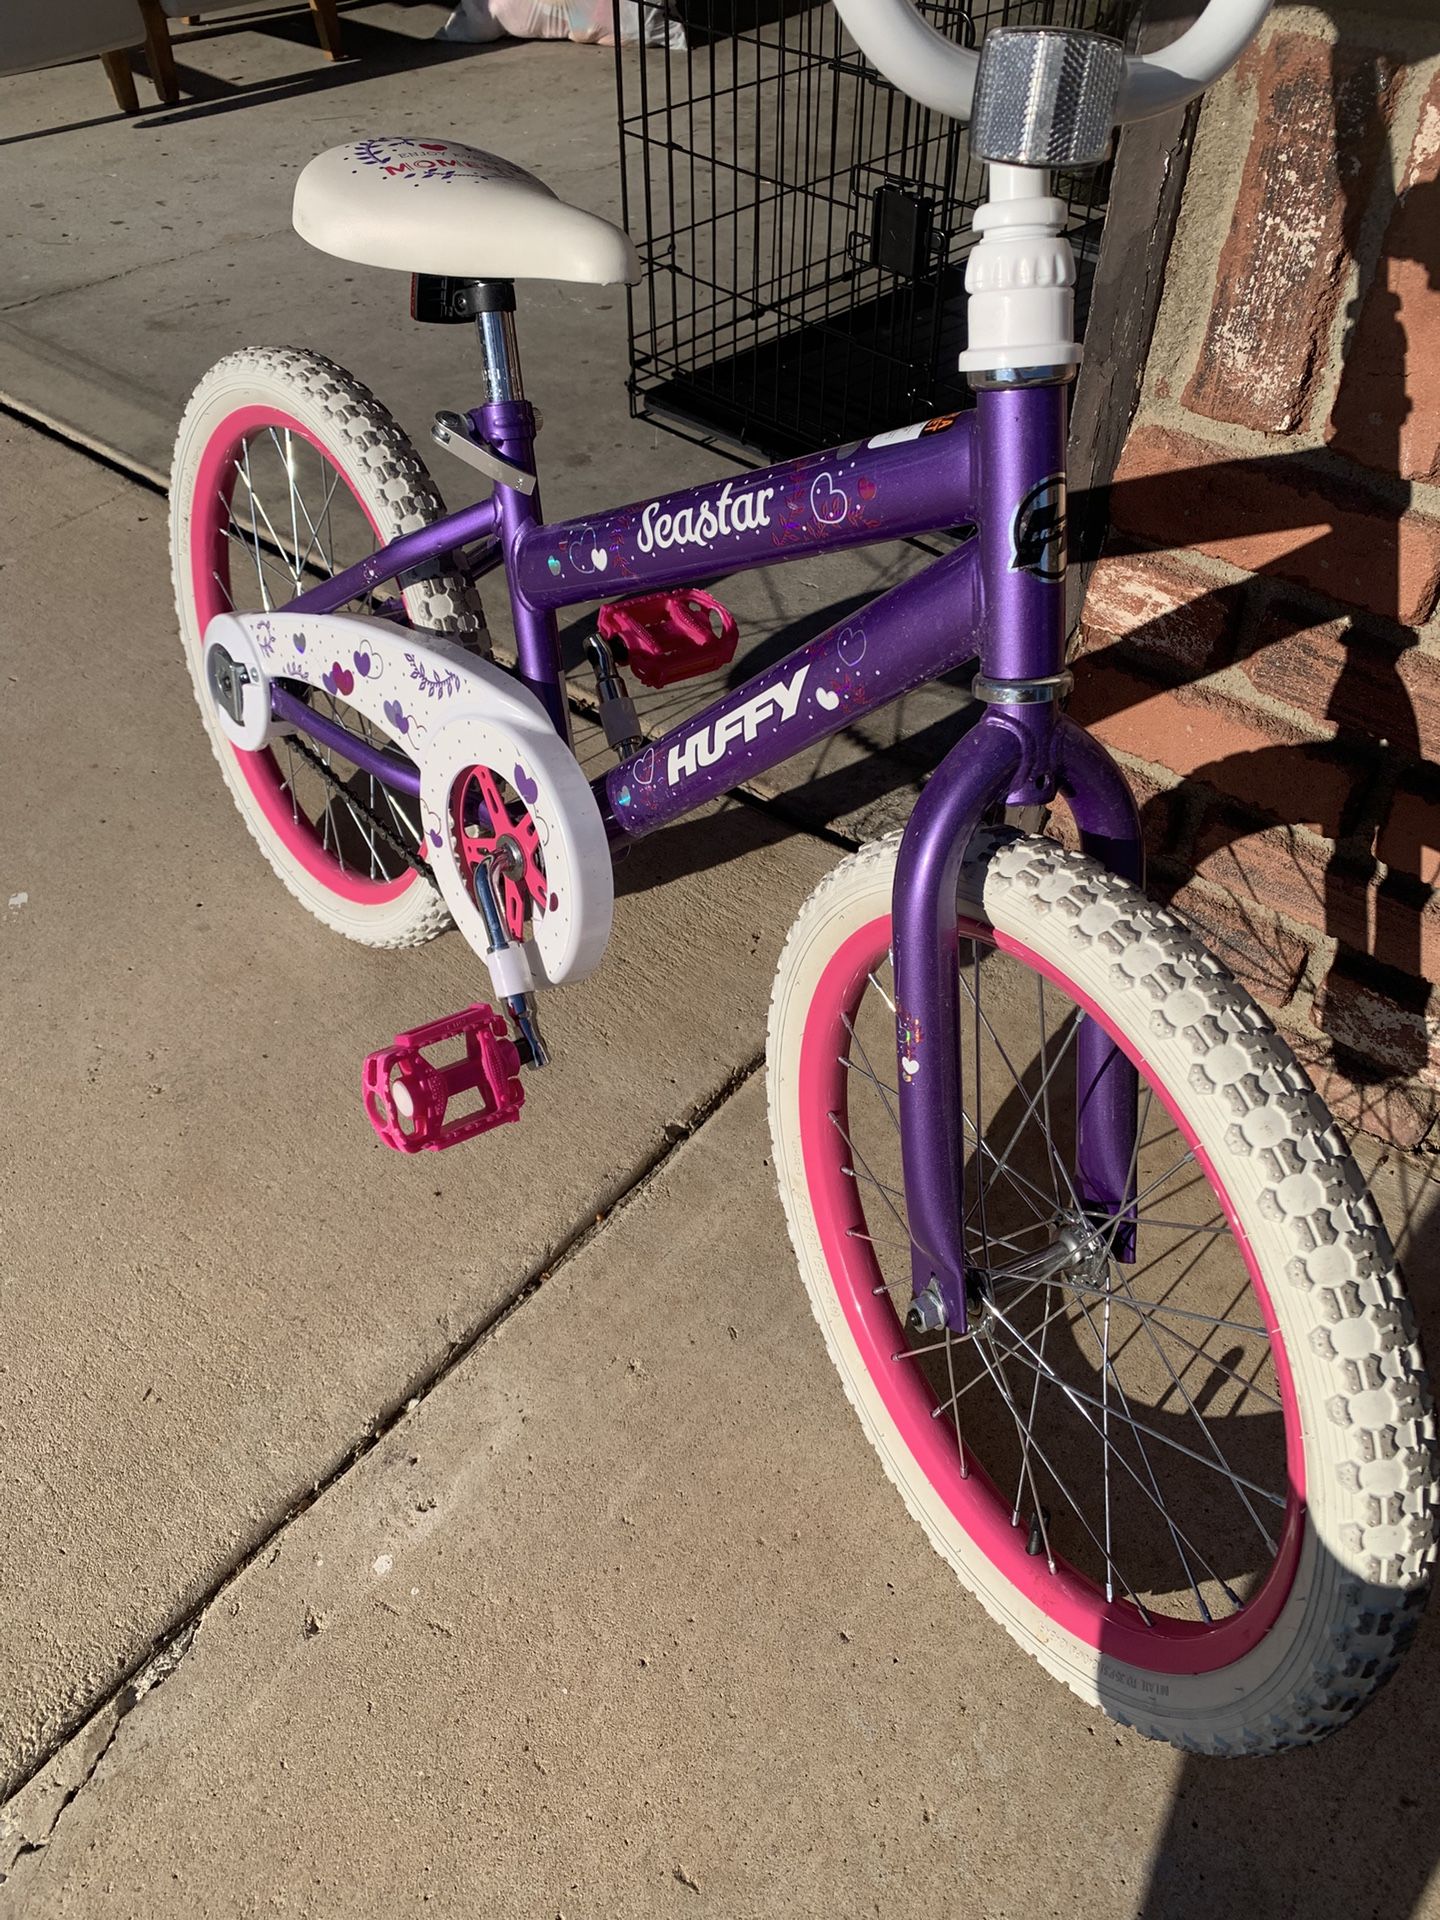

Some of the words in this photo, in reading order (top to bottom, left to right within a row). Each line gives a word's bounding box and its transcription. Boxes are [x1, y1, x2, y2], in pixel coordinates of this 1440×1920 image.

[398, 150, 447, 160] ENJOY
[636, 482, 775, 556] Seastar
[667, 664, 810, 786] HUFFY
